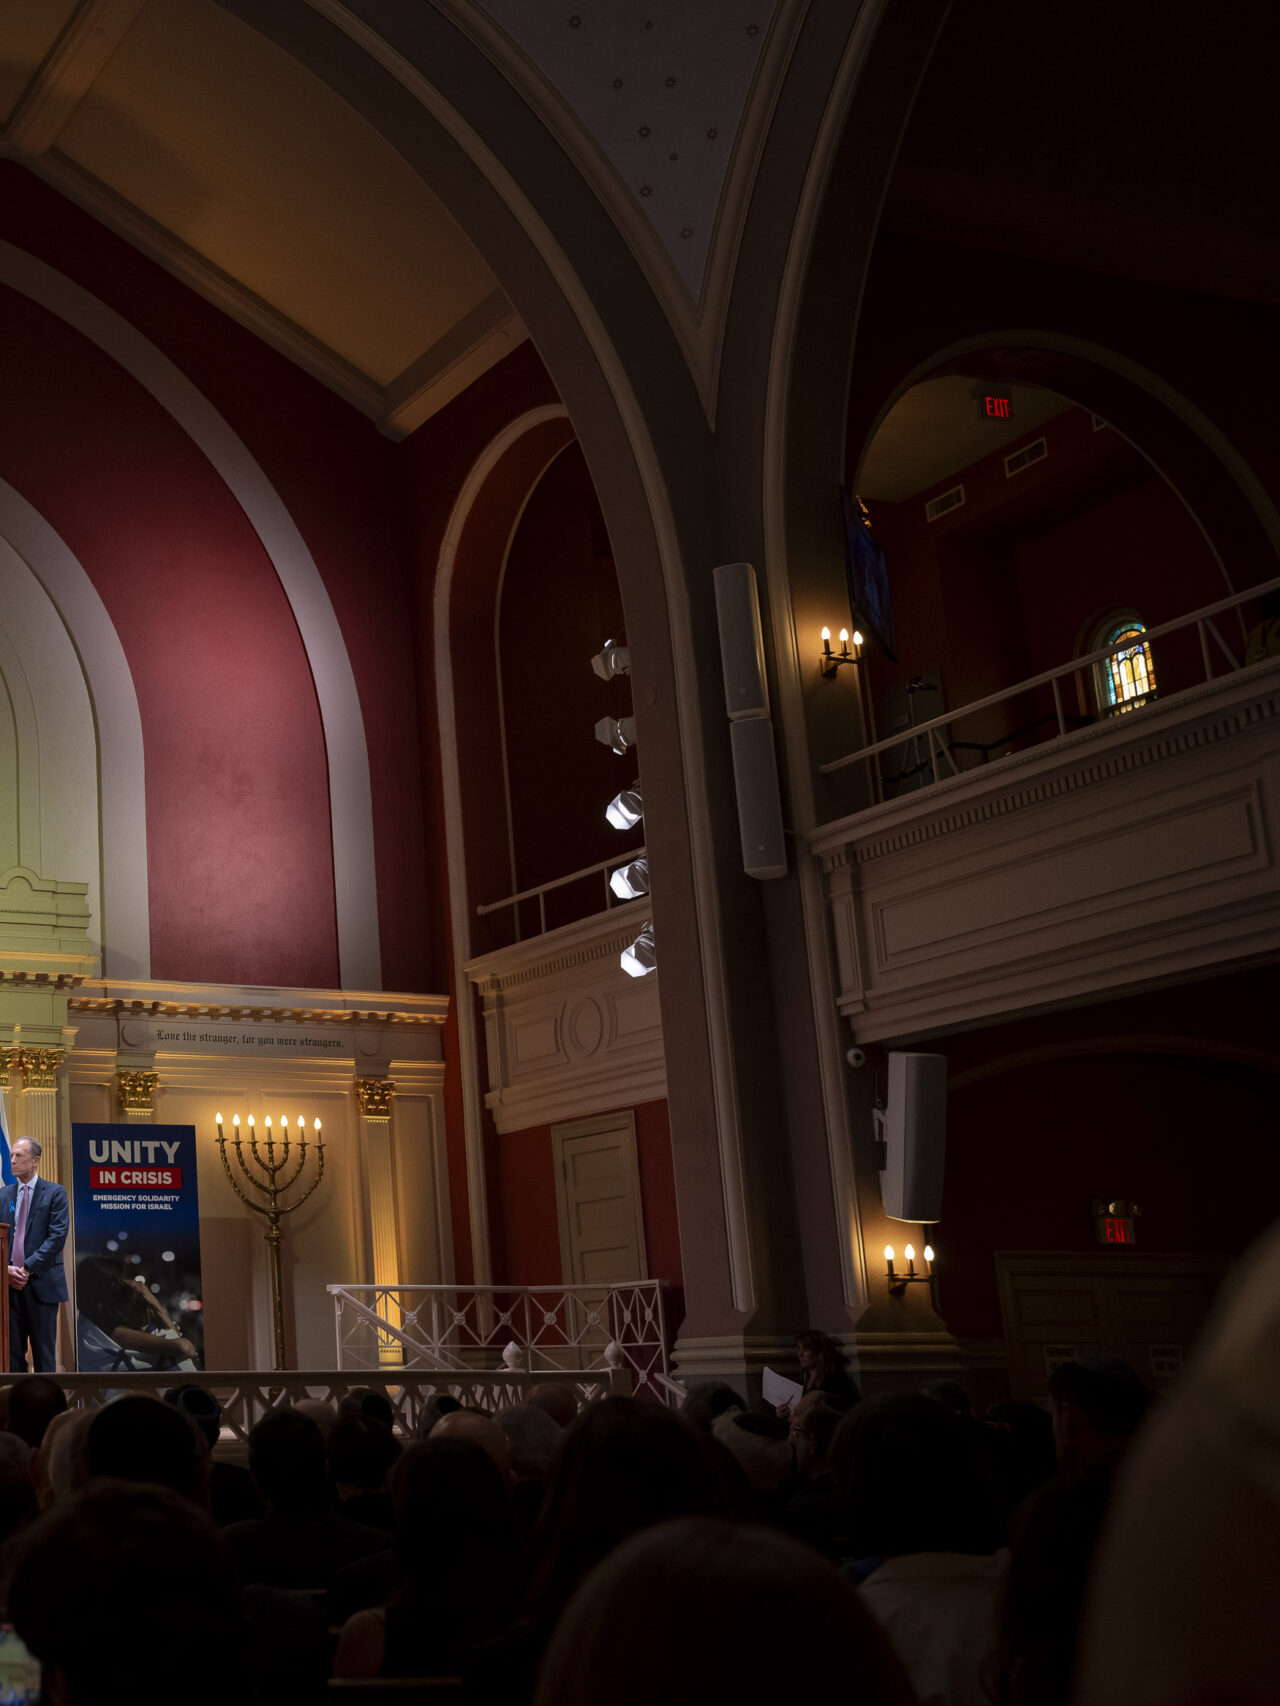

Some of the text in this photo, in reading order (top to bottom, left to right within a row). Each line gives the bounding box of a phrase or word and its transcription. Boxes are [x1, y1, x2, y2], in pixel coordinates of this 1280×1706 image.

[985, 396, 1009, 418] EXIT
[157, 1029, 344, 1048] Love the stranger, for you were strangers.
[89, 1139, 181, 1164] UNITY
[99, 1170, 173, 1185] IN CRISIS
[93, 1194, 137, 1202] EMERGENCY
[1105, 1218, 1130, 1243] EXIT
